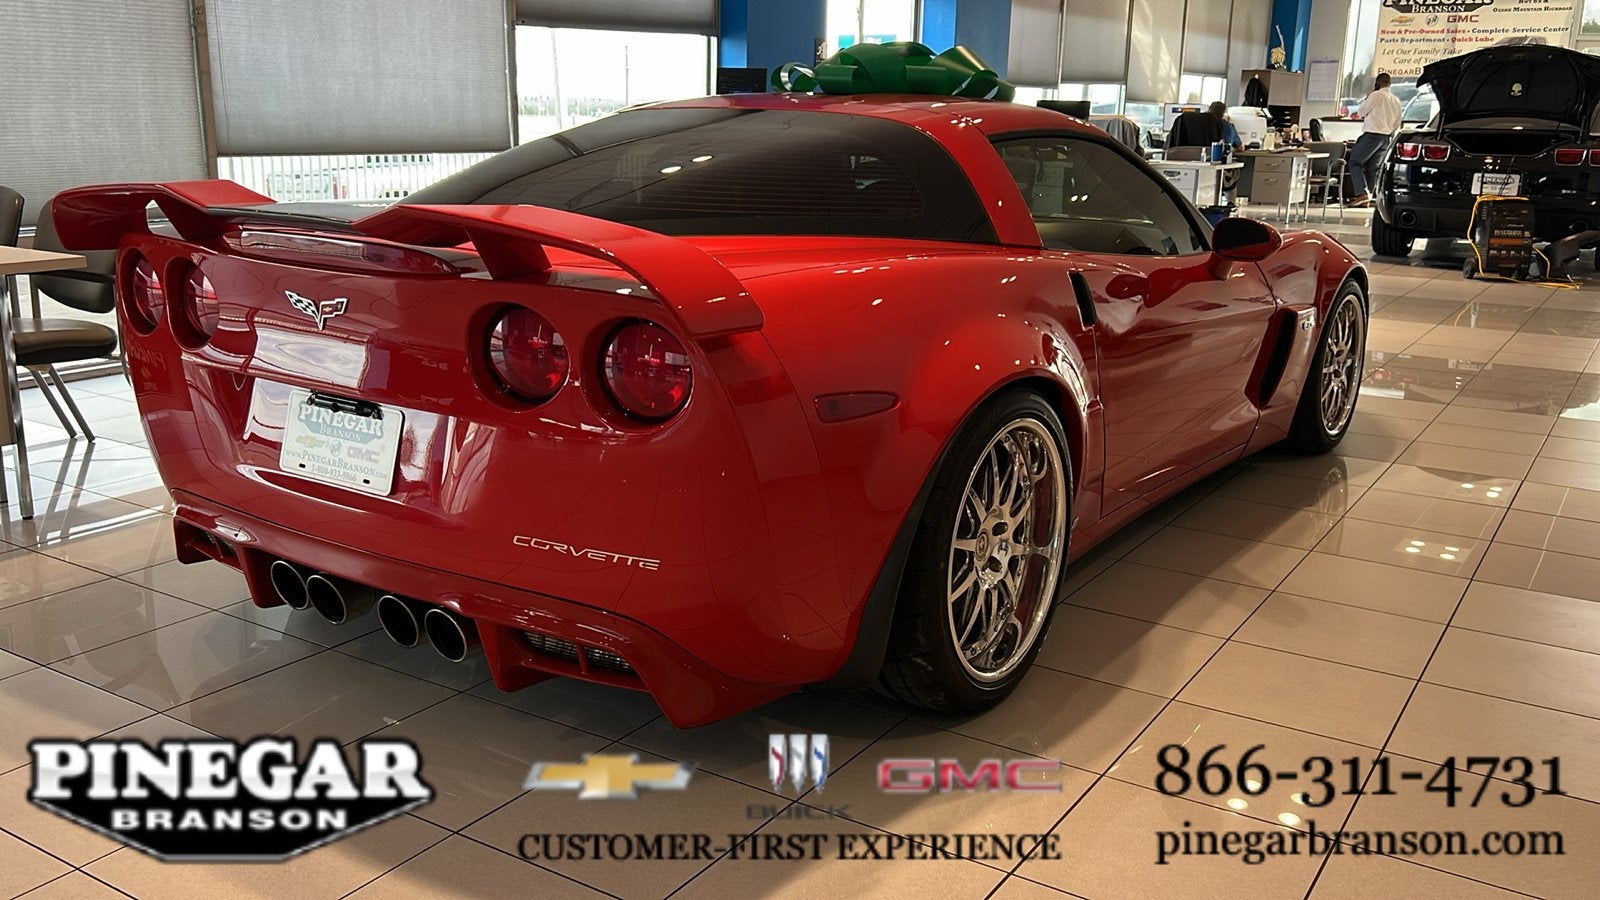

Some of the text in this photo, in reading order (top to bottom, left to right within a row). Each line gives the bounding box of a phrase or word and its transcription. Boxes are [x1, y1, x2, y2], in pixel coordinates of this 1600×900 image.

[1412, 4, 1466, 13] BRANSON
[1446, 14, 1480, 23] GMC
[1472, 27, 1510, 35] Complete
[1413, 48, 1440, 56] Family
[1443, 47, 1463, 55] Take
[1413, 56, 1423, 65] of
[298, 404, 383, 436] PINEGAR
[320, 424, 362, 442] BRANSON
[348, 446, 380, 463] GMC
[513, 535, 661, 571] CORVETTE
